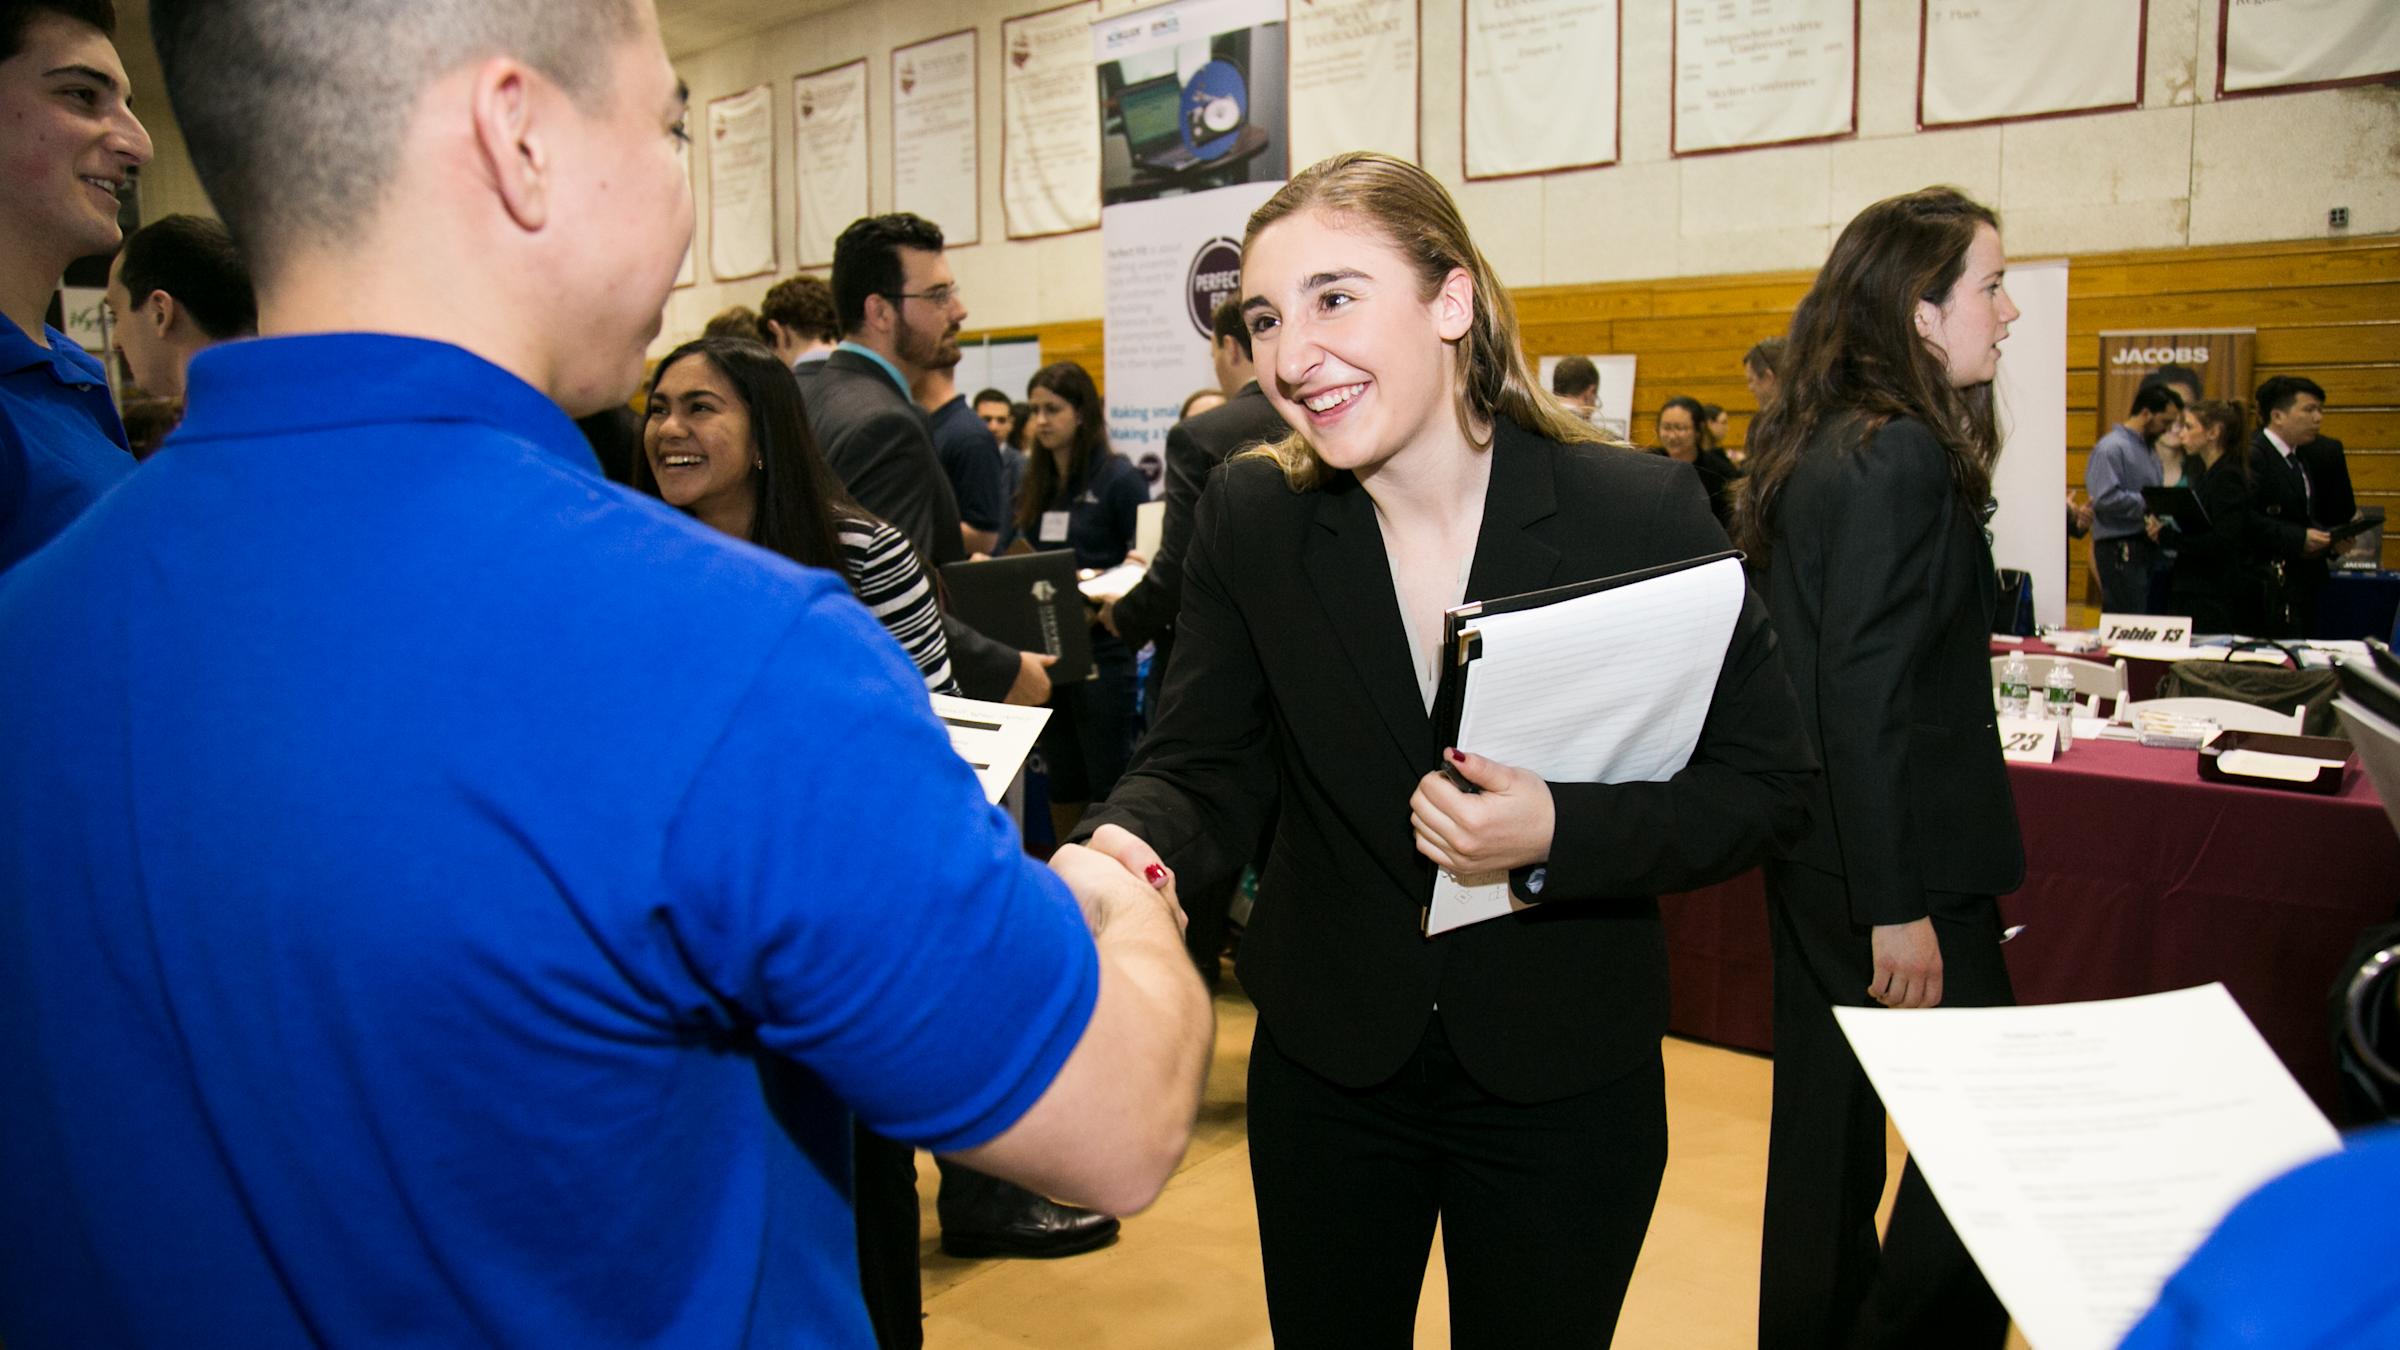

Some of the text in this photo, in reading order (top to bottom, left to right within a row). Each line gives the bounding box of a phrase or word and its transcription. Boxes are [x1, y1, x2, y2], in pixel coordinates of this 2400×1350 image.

[2112, 347, 2209, 365] JACOBS
[1110, 404, 1148, 422] Making
[1110, 425, 1149, 444] Making
[2107, 626, 2184, 643] Table 13
[2002, 732, 2045, 752] 23
